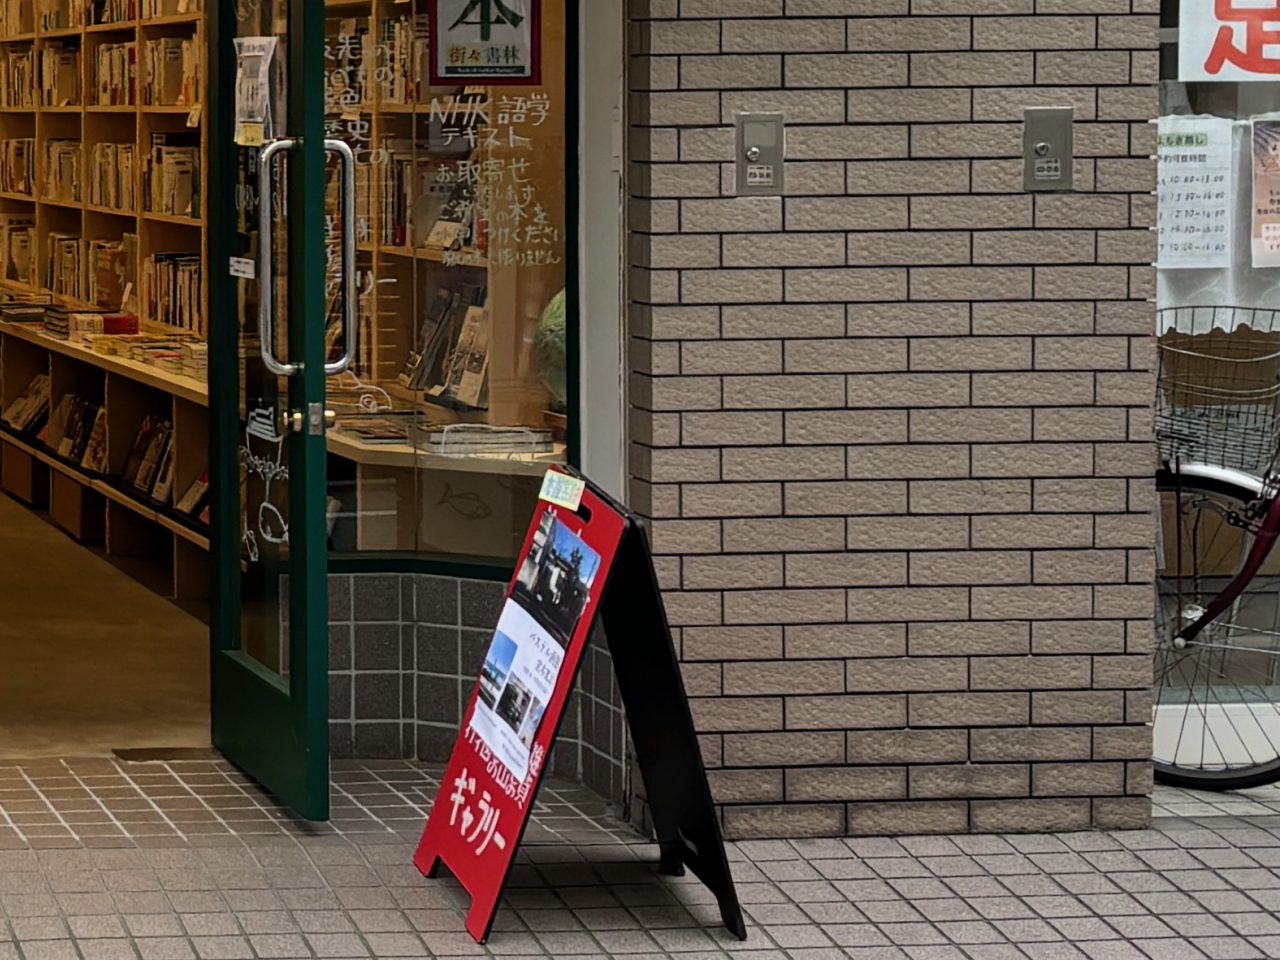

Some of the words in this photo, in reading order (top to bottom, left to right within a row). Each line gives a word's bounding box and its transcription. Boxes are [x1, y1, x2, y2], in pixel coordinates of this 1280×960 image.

[448, 44, 521, 65] 街々書林
[429, 95, 492, 127] NHK
[496, 92, 552, 126] 語学
[441, 127, 533, 150] テキスト
[436, 158, 532, 186] お取寄せ
[448, 767, 507, 857] ギャラリー
